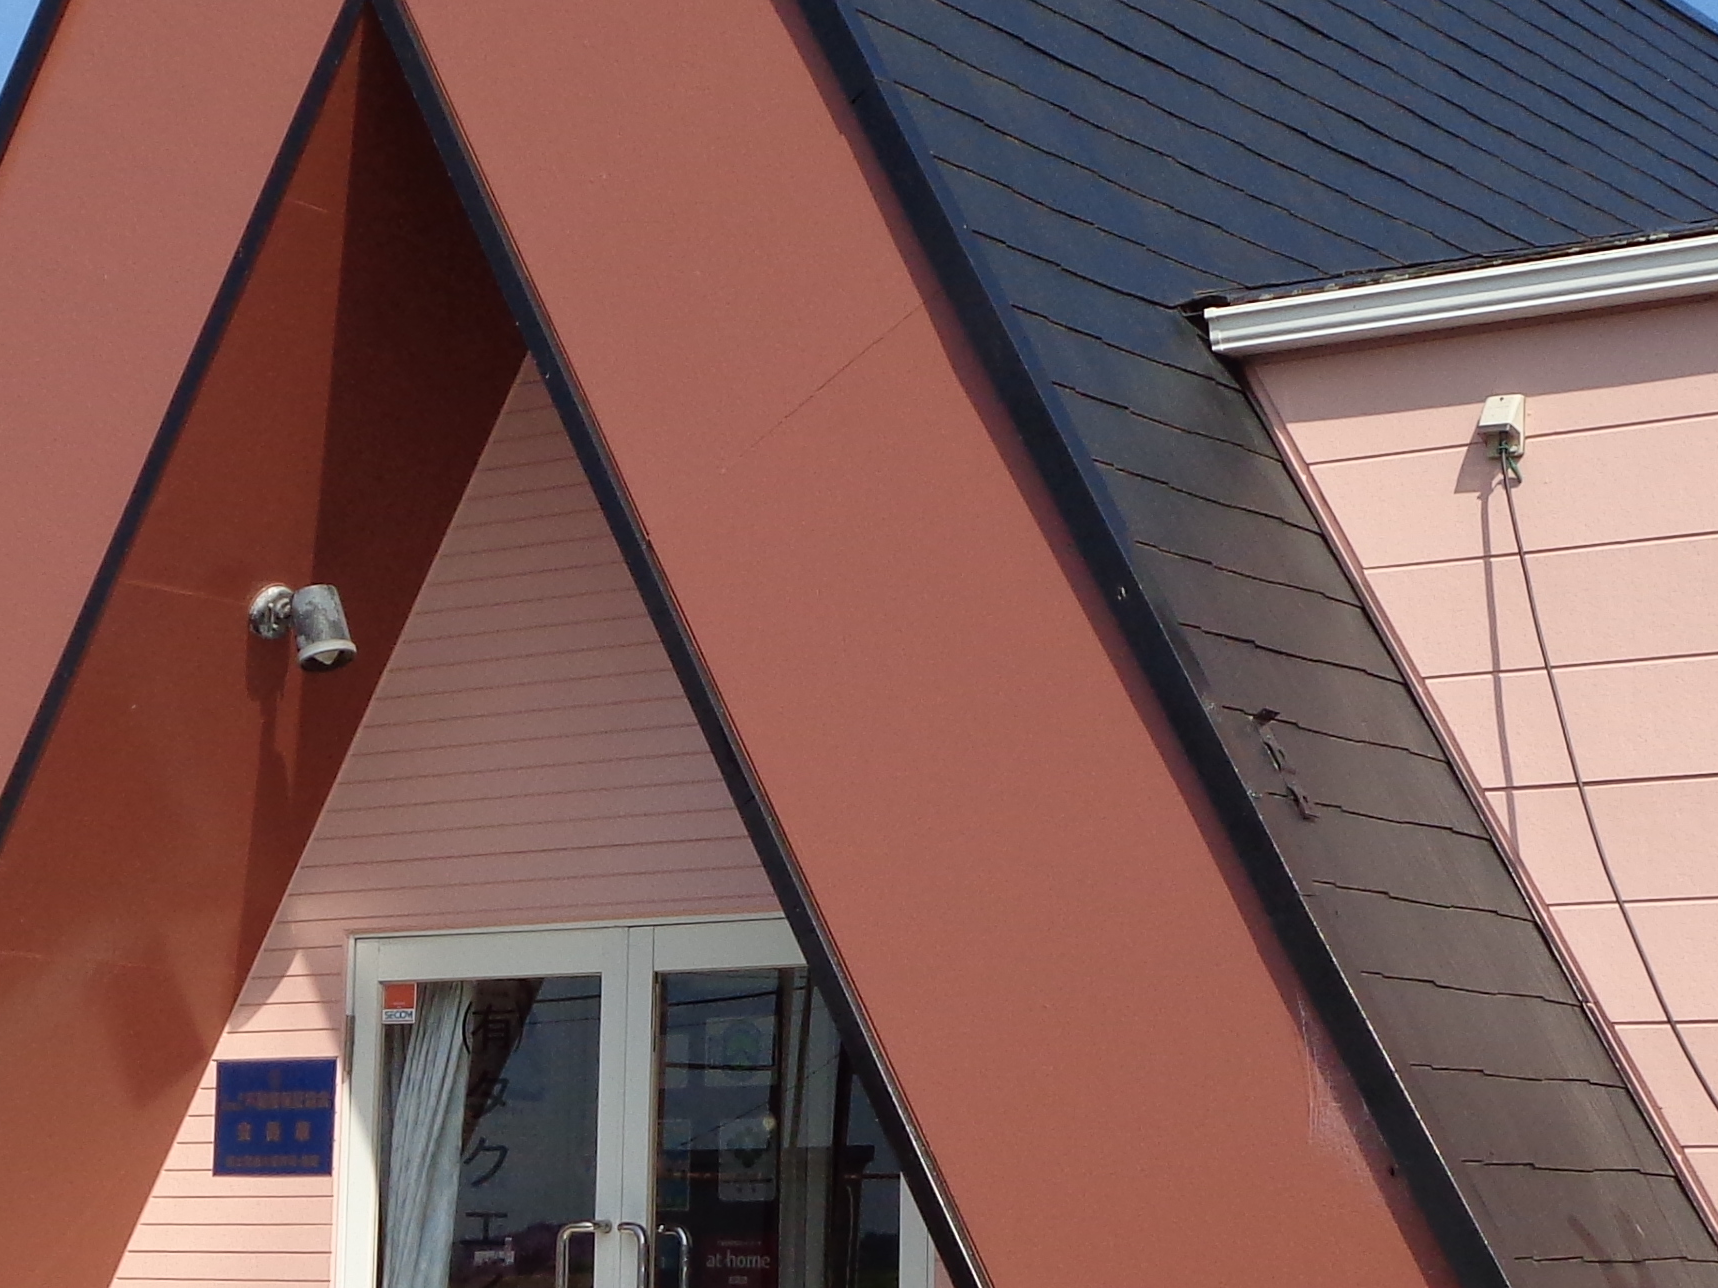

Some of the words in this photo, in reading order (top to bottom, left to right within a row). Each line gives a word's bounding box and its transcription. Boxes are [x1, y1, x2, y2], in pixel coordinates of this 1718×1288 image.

[384, 1010, 413, 1019] SECOM
[706, 1253, 722, 1268] at
[726, 1249, 770, 1268] home
